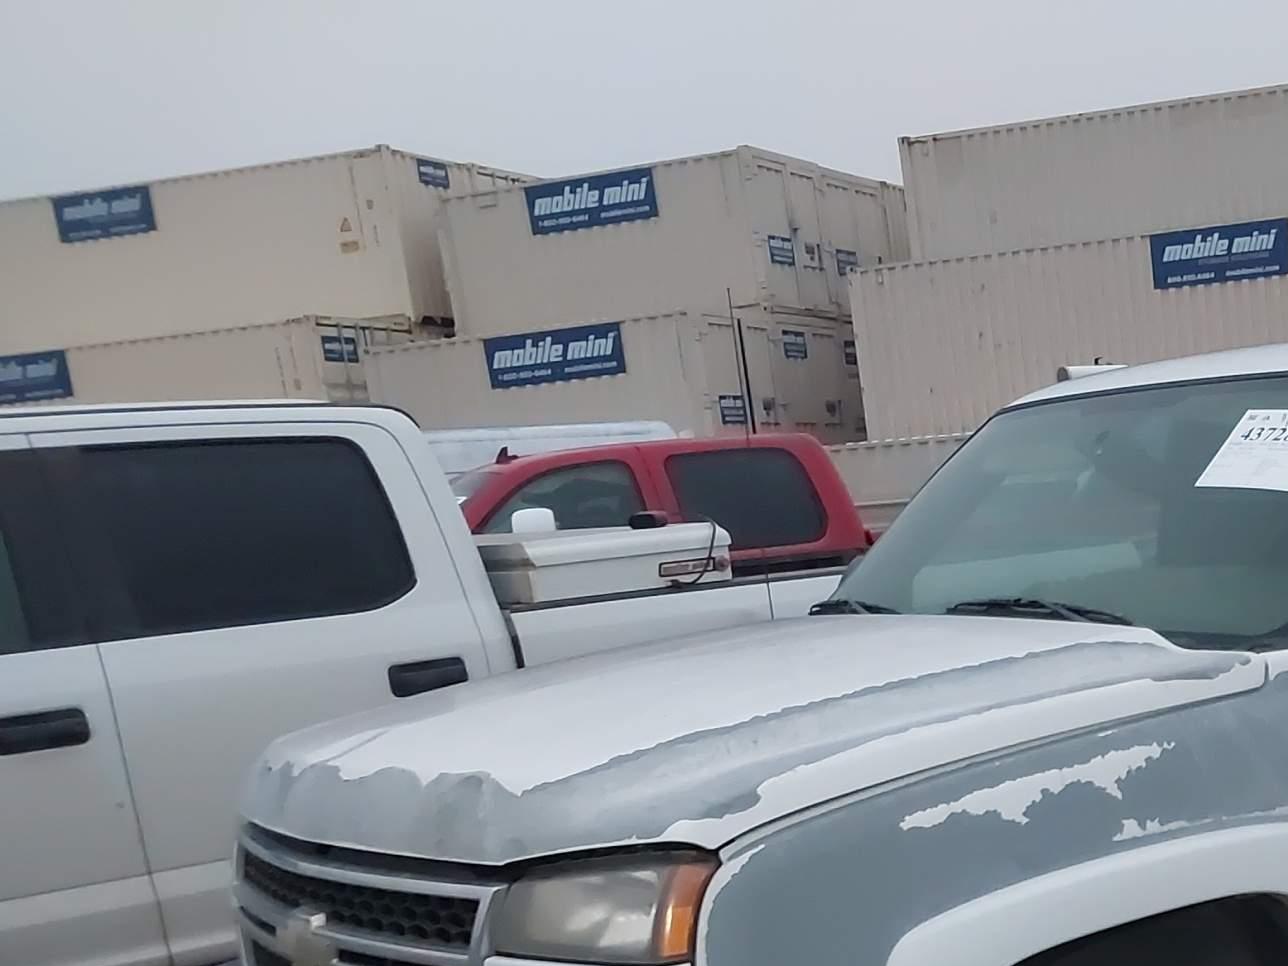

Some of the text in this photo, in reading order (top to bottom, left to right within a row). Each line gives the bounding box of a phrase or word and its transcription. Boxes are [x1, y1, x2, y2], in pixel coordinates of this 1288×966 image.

[533, 182, 600, 216] mobile
[602, 177, 648, 206] mini
[1162, 232, 1229, 262] mobile
[1231, 229, 1277, 254] mini
[493, 331, 614, 369] mobile mini
